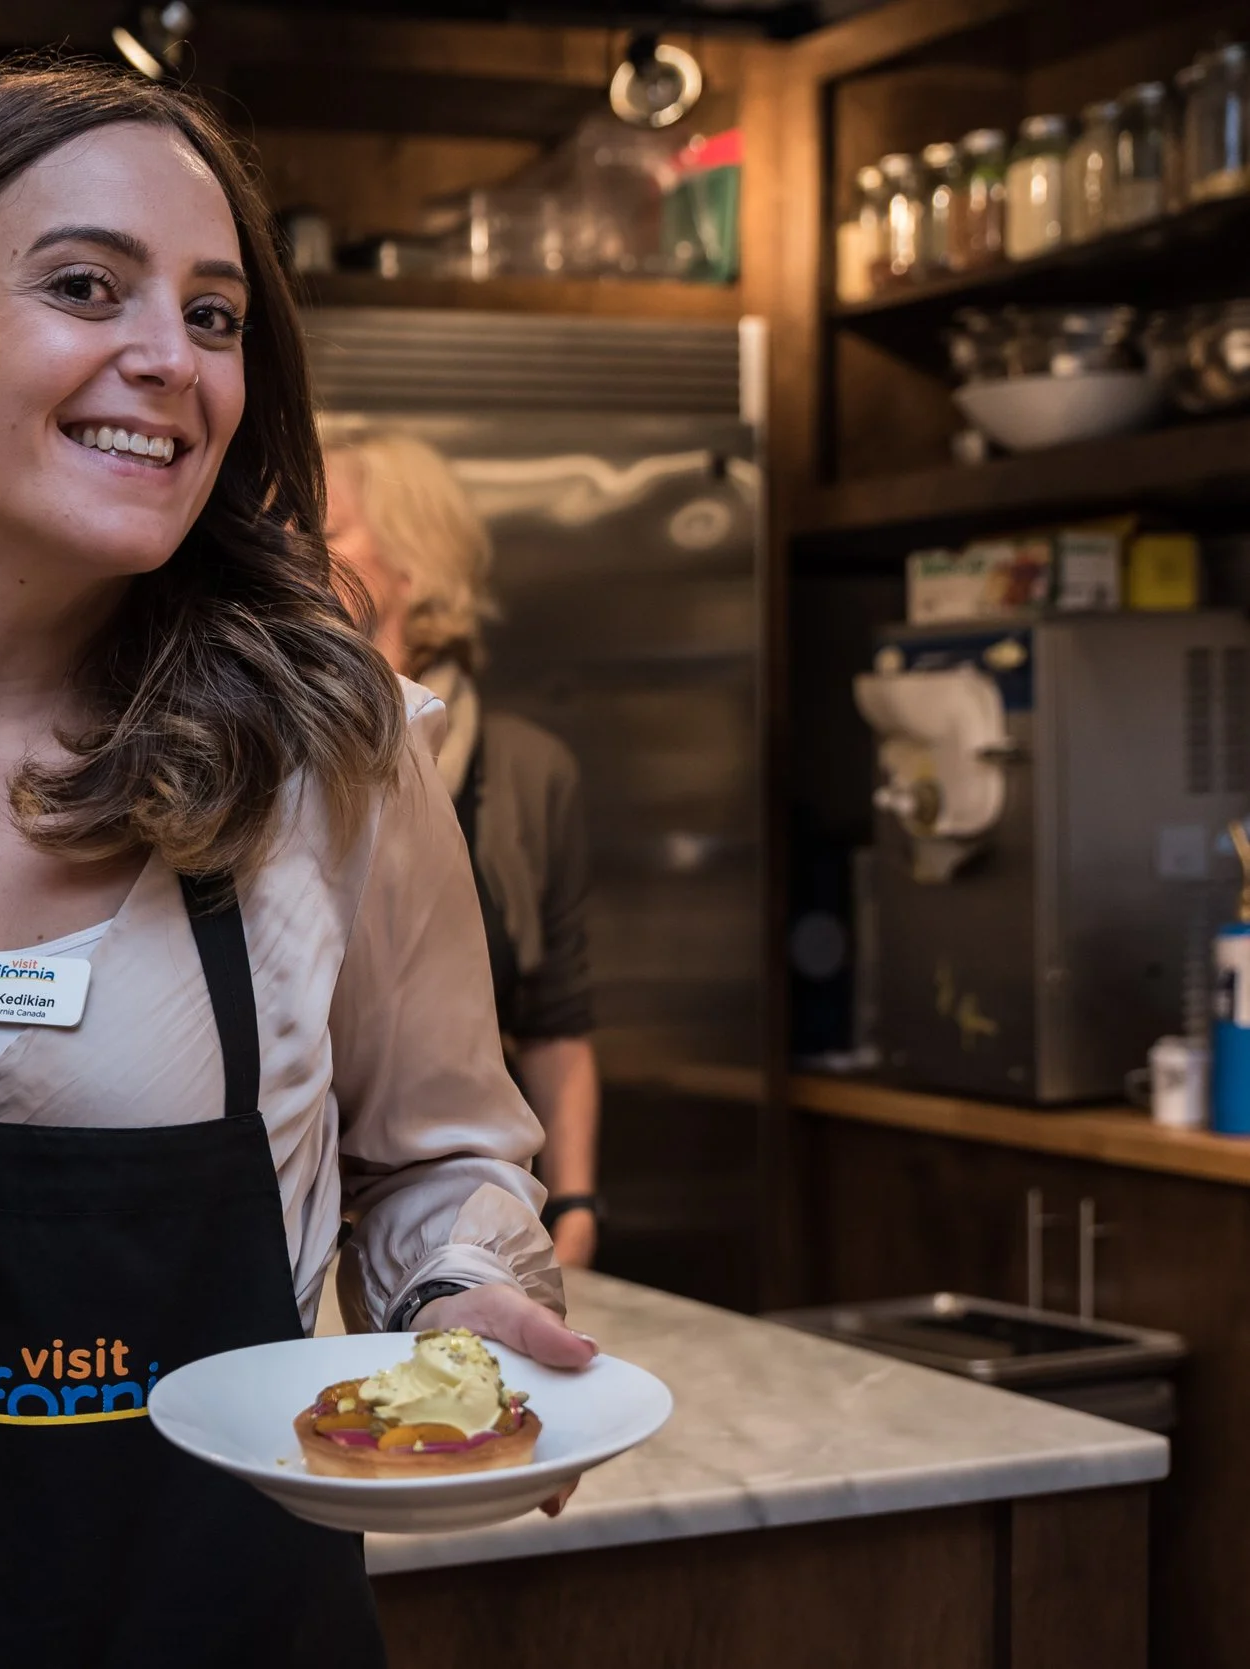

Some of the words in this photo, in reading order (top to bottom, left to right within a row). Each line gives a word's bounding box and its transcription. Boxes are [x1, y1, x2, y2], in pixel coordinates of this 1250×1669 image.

[12, 958, 38, 969] visit
[16, 1008, 46, 1018] Canada
[21, 1338, 129, 1380] visit
